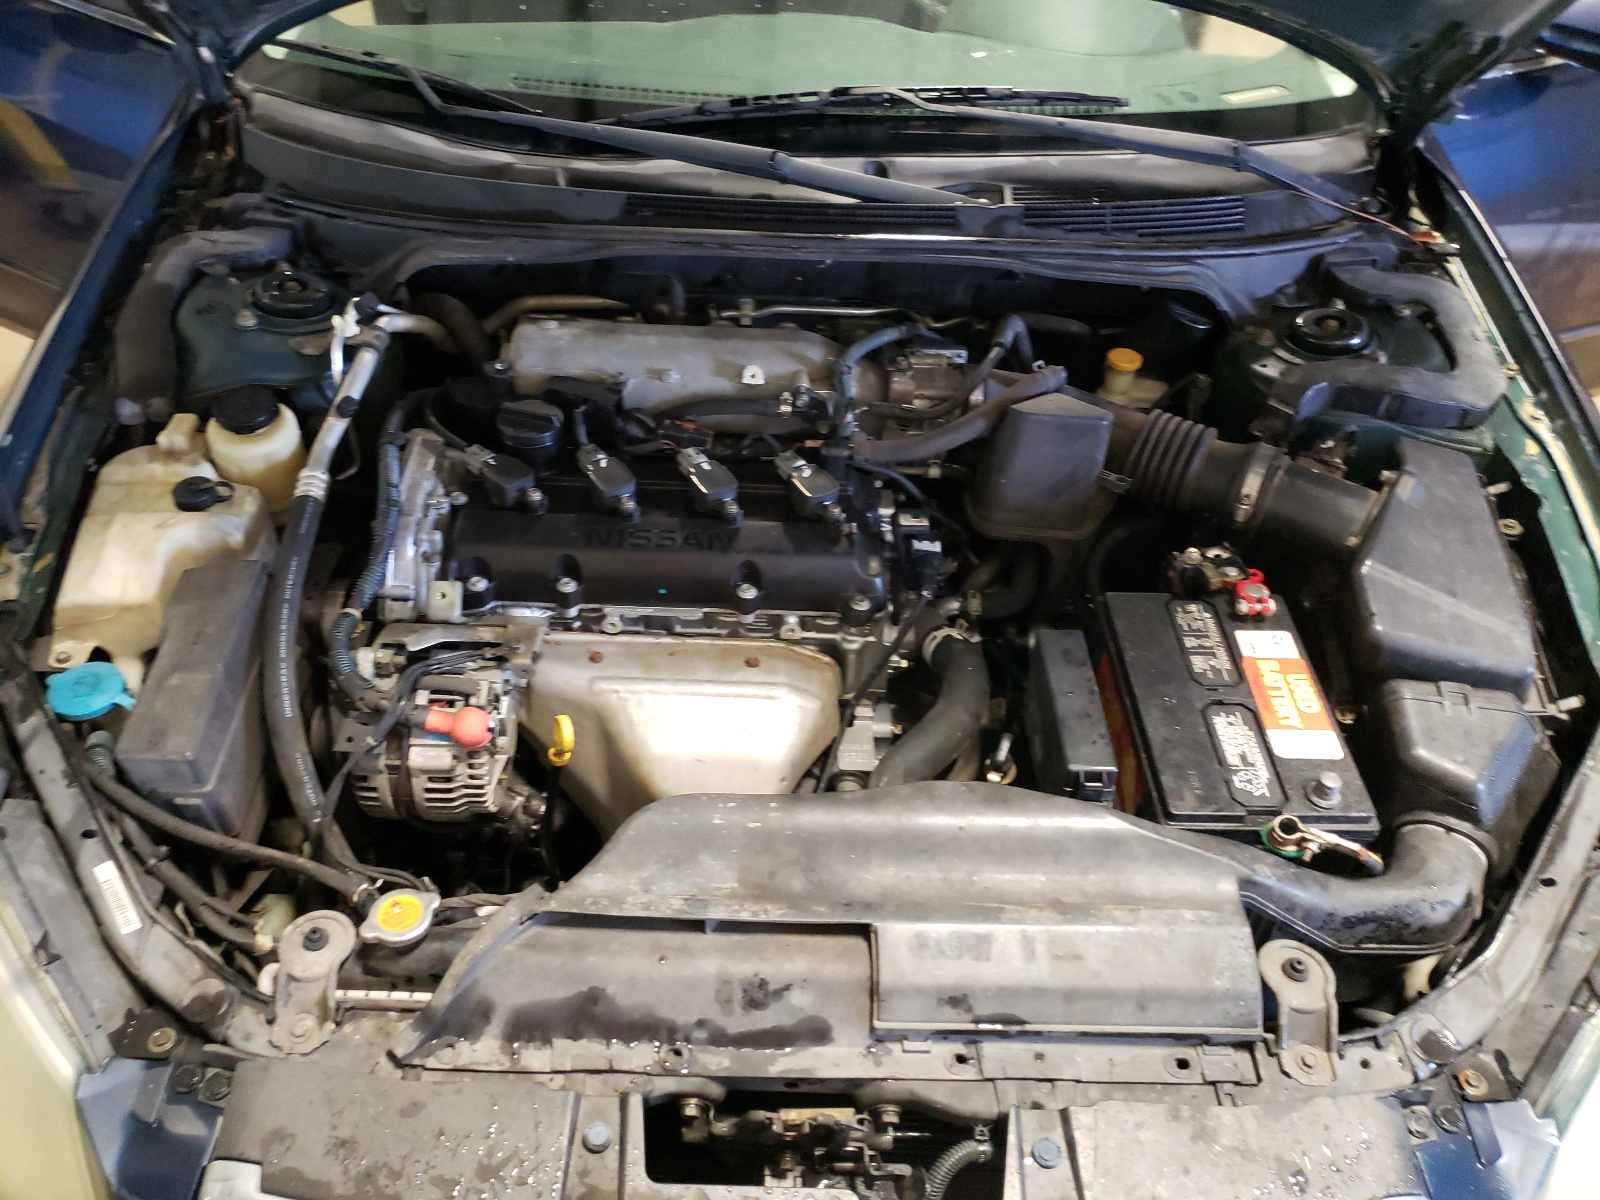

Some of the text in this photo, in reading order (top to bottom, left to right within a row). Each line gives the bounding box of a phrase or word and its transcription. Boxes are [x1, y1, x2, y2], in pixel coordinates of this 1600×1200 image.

[585, 527, 738, 551] NISSAN
[1256, 659, 1305, 729] BATTERY
[1286, 673, 1321, 713] USED
